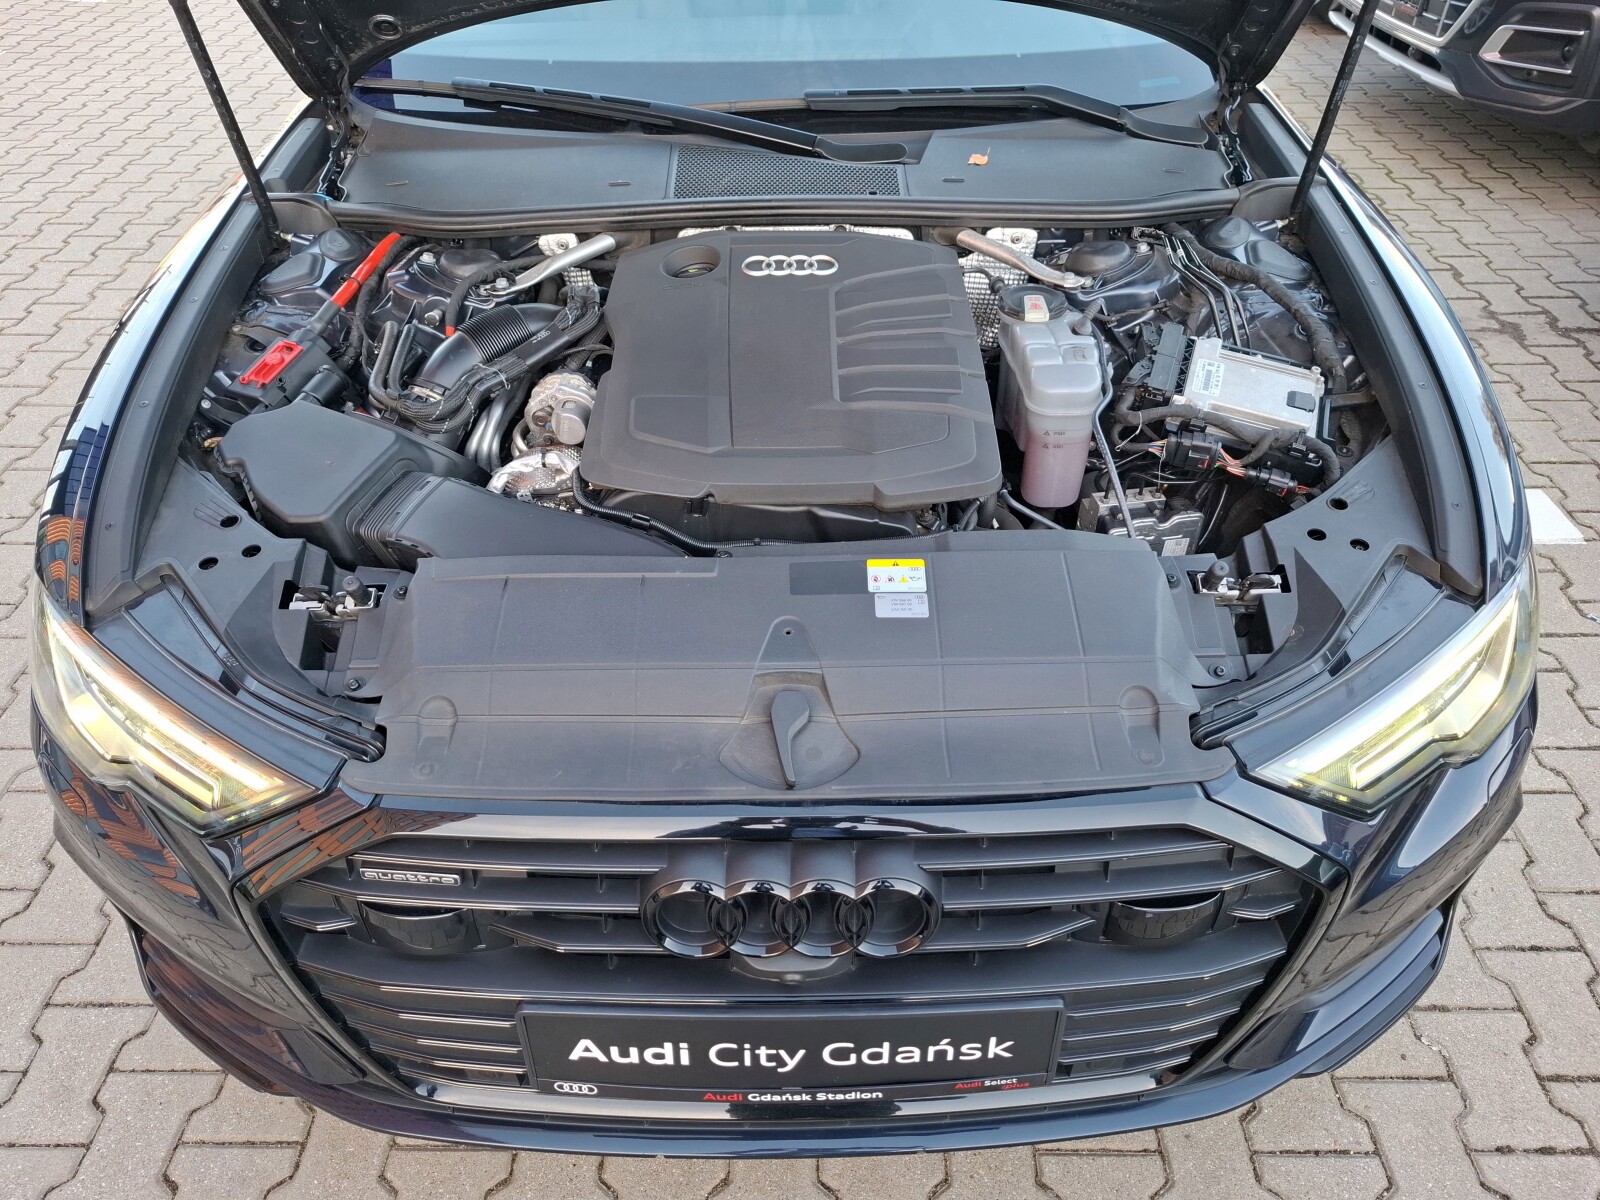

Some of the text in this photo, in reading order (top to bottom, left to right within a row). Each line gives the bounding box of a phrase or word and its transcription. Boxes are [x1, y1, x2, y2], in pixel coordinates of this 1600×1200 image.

[364, 871, 455, 883] quattro
[568, 1036, 1015, 1072] Audi City Gdańsk
[954, 1078, 1018, 1089] Audi Select
[703, 1091, 883, 1101] Audi Gdańsk Stadion
